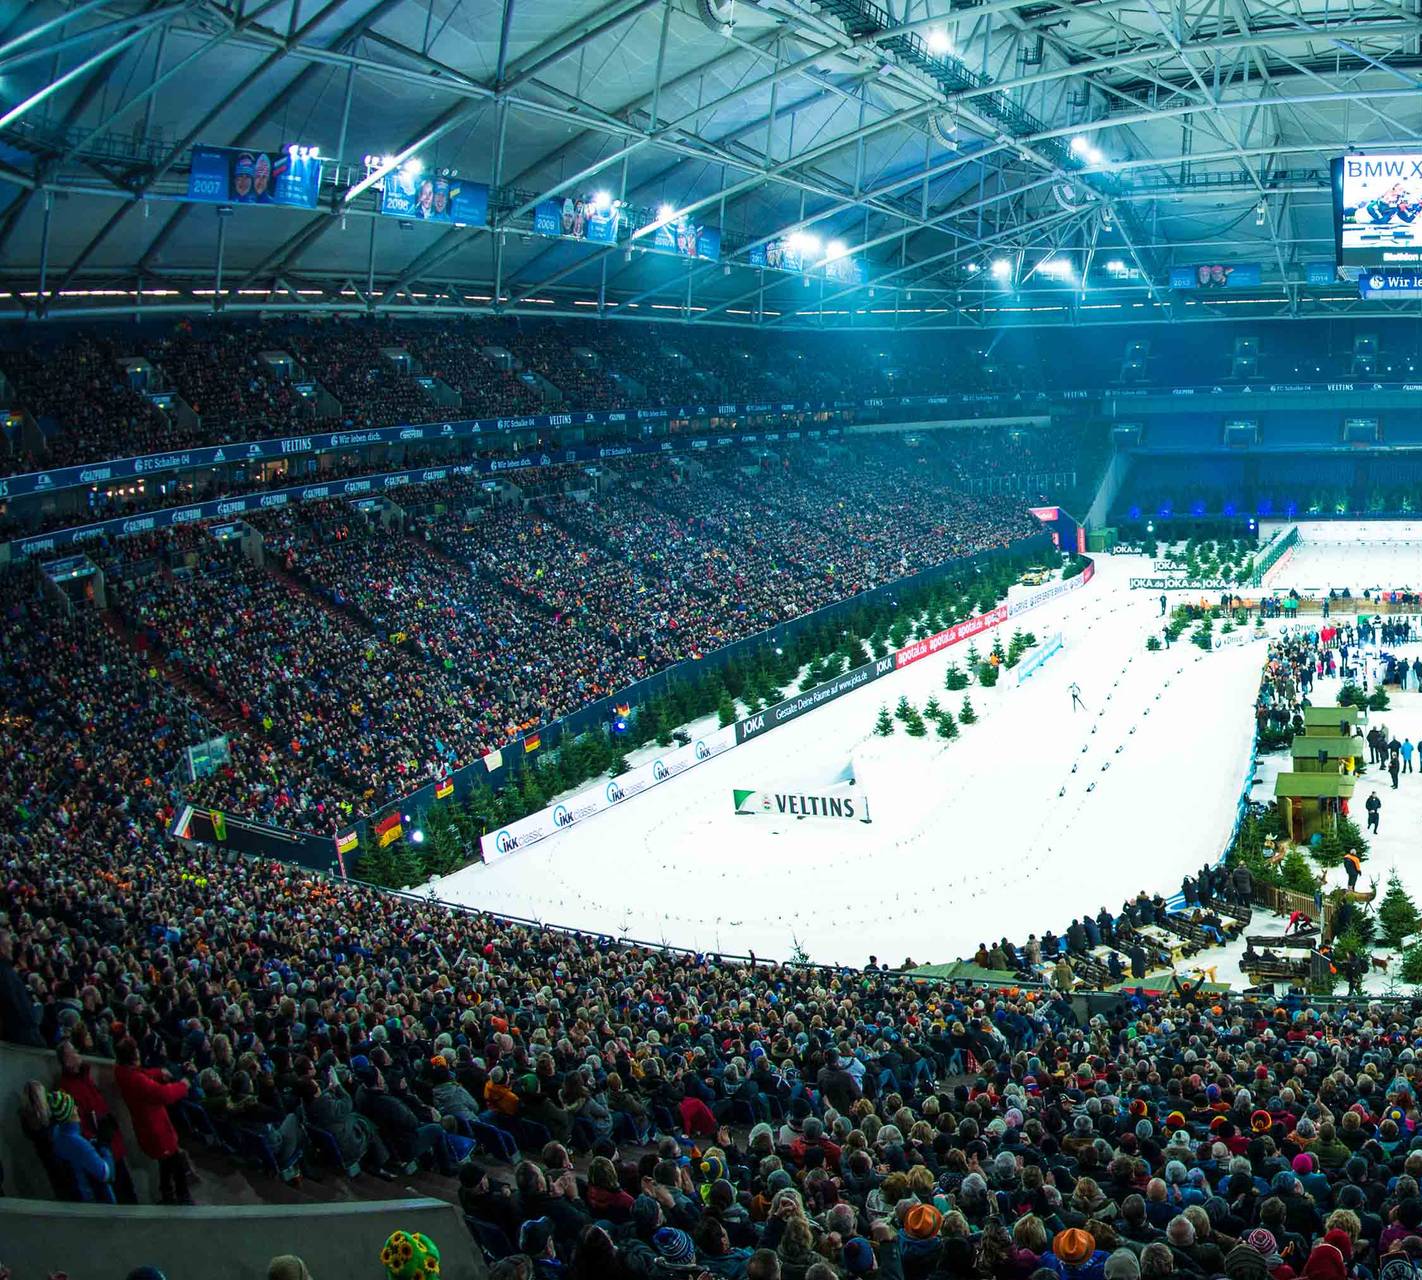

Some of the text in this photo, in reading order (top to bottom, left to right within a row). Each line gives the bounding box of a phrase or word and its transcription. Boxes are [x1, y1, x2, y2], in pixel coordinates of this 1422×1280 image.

[1348, 161, 1405, 177] BMW
[194, 181, 220, 193] 2007
[1388, 277, 1411, 287] Wir
[549, 415, 571, 426] VELTINS
[281, 438, 312, 452] VELTINS
[339, 436, 350, 444] Wir
[144, 459, 154, 470] FC
[154, 456, 180, 468] Schalke
[1155, 561, 1188, 570] JOKA.de
[1130, 579, 1163, 588] JOKA.de
[1164, 579, 1200, 588] JOKA.de
[1202, 579, 1238, 588] JOKA.de
[898, 643, 927, 665] apotal.de
[743, 715, 764, 738] JOKA
[798, 696, 813, 710] Deine
[813, 689, 831, 703] Räume
[831, 682, 839, 694] auf
[876, 657, 893, 676] JOKA
[775, 794, 854, 817] VELTINS
